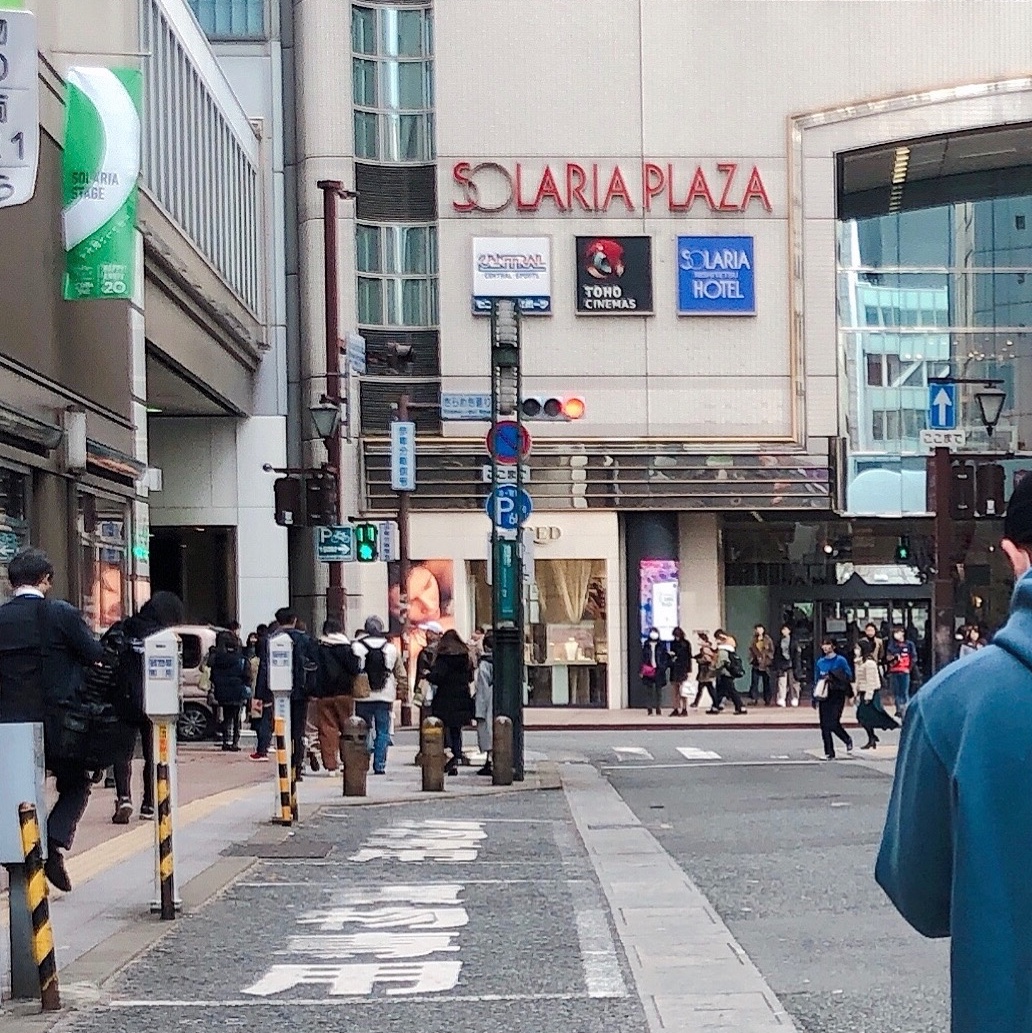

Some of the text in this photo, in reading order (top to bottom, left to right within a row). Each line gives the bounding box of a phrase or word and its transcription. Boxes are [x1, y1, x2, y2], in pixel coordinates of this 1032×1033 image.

[453, 162, 772, 212] SOLARIA PLAZA
[681, 249, 751, 270] SOLARIA
[585, 285, 622, 298] TOHO
[693, 279, 745, 299] HOTEL
[585, 299, 637, 309] CINEMAS
[923, 432, 966, 446] ここまで
[320, 530, 333, 544] P
